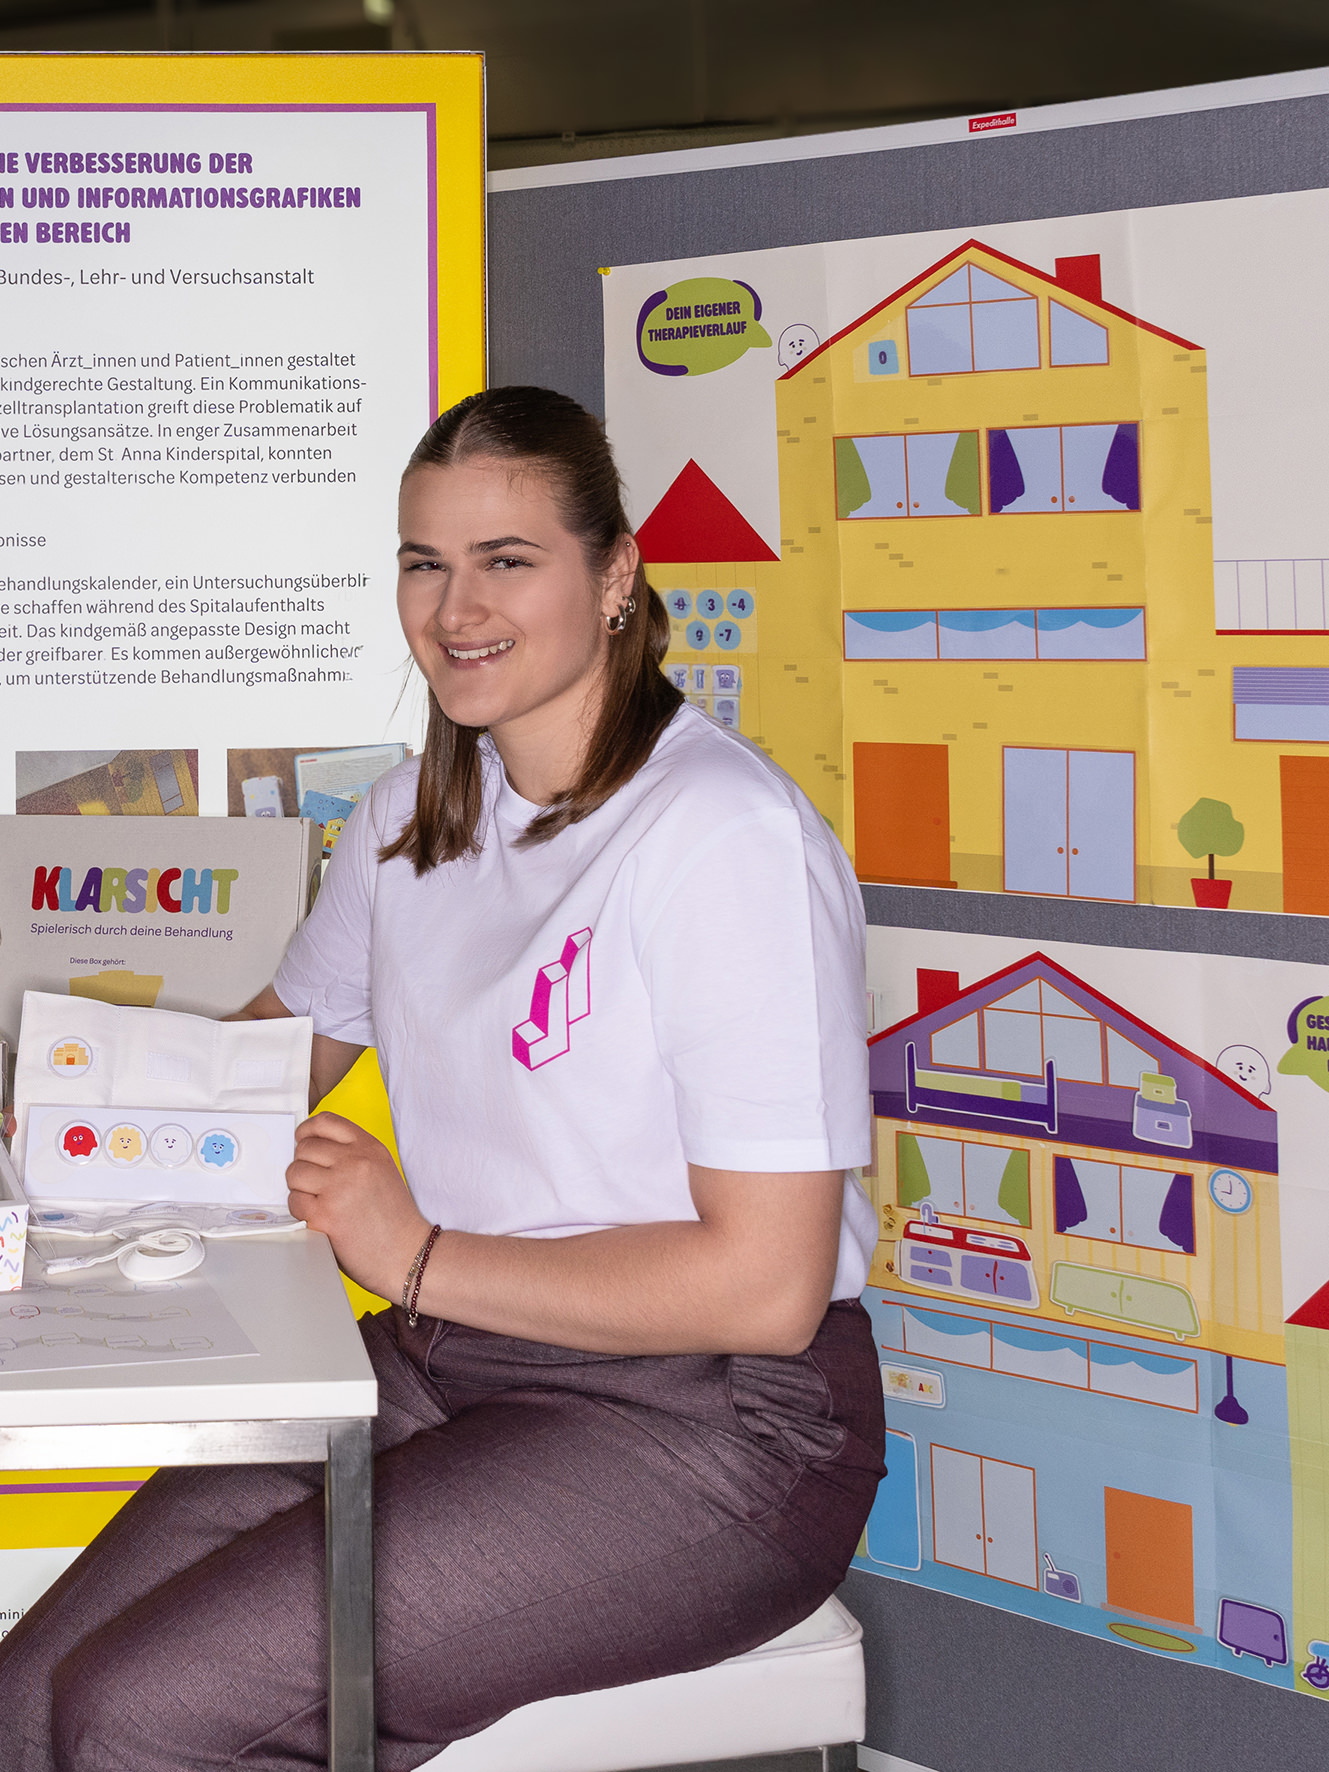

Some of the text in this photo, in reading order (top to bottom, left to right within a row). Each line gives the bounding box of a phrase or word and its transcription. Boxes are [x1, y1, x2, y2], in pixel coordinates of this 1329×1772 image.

[972, 116, 1015, 129] Expedithalle
[24, 151, 201, 173] VERBESSERUNG
[208, 152, 252, 174] DER
[21, 186, 70, 208] UND
[77, 186, 360, 208] INFORMATIONSGRAFIKEN
[35, 221, 130, 243] BEREICH
[80, 268, 126, 284] Lehr-
[131, 268, 164, 284] und
[169, 267, 314, 284] Versuchsanstalt
[666, 301, 741, 321] DEIN EIGENER
[648, 321, 748, 342] THERAPIEVERLAUF
[50, 350, 136, 369] Ärzt_innen
[140, 352, 169, 367] und
[175, 353, 283, 369] Patient_innen
[286, 351, 356, 370] gestaltet
[0, 376, 103, 395] kindgerechte
[107, 376, 195, 394] Gestaltung.
[200, 376, 224, 390] Ein
[229, 375, 366, 390] Kommunikations-
[147, 399, 189, 418] greift
[192, 399, 234, 414] diese
[239, 398, 333, 413] Problematik
[336, 397, 362, 413] auf
[23, 423, 152, 441] Lösungsansätze.
[157, 423, 171, 437] In
[175, 425, 219, 441] enger
[223, 421, 357, 437] Zusammenarbeit
[58, 446, 93, 461] dem
[121, 447, 161, 461] Anna
[166, 445, 263, 464] Kinderspital,
[268, 445, 331, 460] konnten
[30, 470, 59, 485] und
[63, 469, 175, 488] gestalterische
[179, 470, 268, 486] Kompetenz
[271, 468, 355, 483] verbunden
[164, 575, 188, 589] ein
[13, 599, 82, 614] schaffen
[85, 598, 153, 613] während
[158, 598, 186, 613] des
[189, 597, 324, 616] Spitalaufenthalts
[27, 623, 55, 638] Das
[60, 622, 146, 641] kindgemäß
[150, 623, 240, 640] angepasste
[244, 621, 296, 639] Design
[300, 620, 350, 635] macht
[111, 646, 128, 660] Es
[132, 645, 200, 660] kommen
[5, 674, 30, 685] um
[34, 669, 156, 685] unterstützende
[31, 865, 240, 915] KLARSICHT
[30, 922, 234, 941] Spielerisch durch deine Behandlung
[69, 957, 126, 967] Diese Box gehört:
